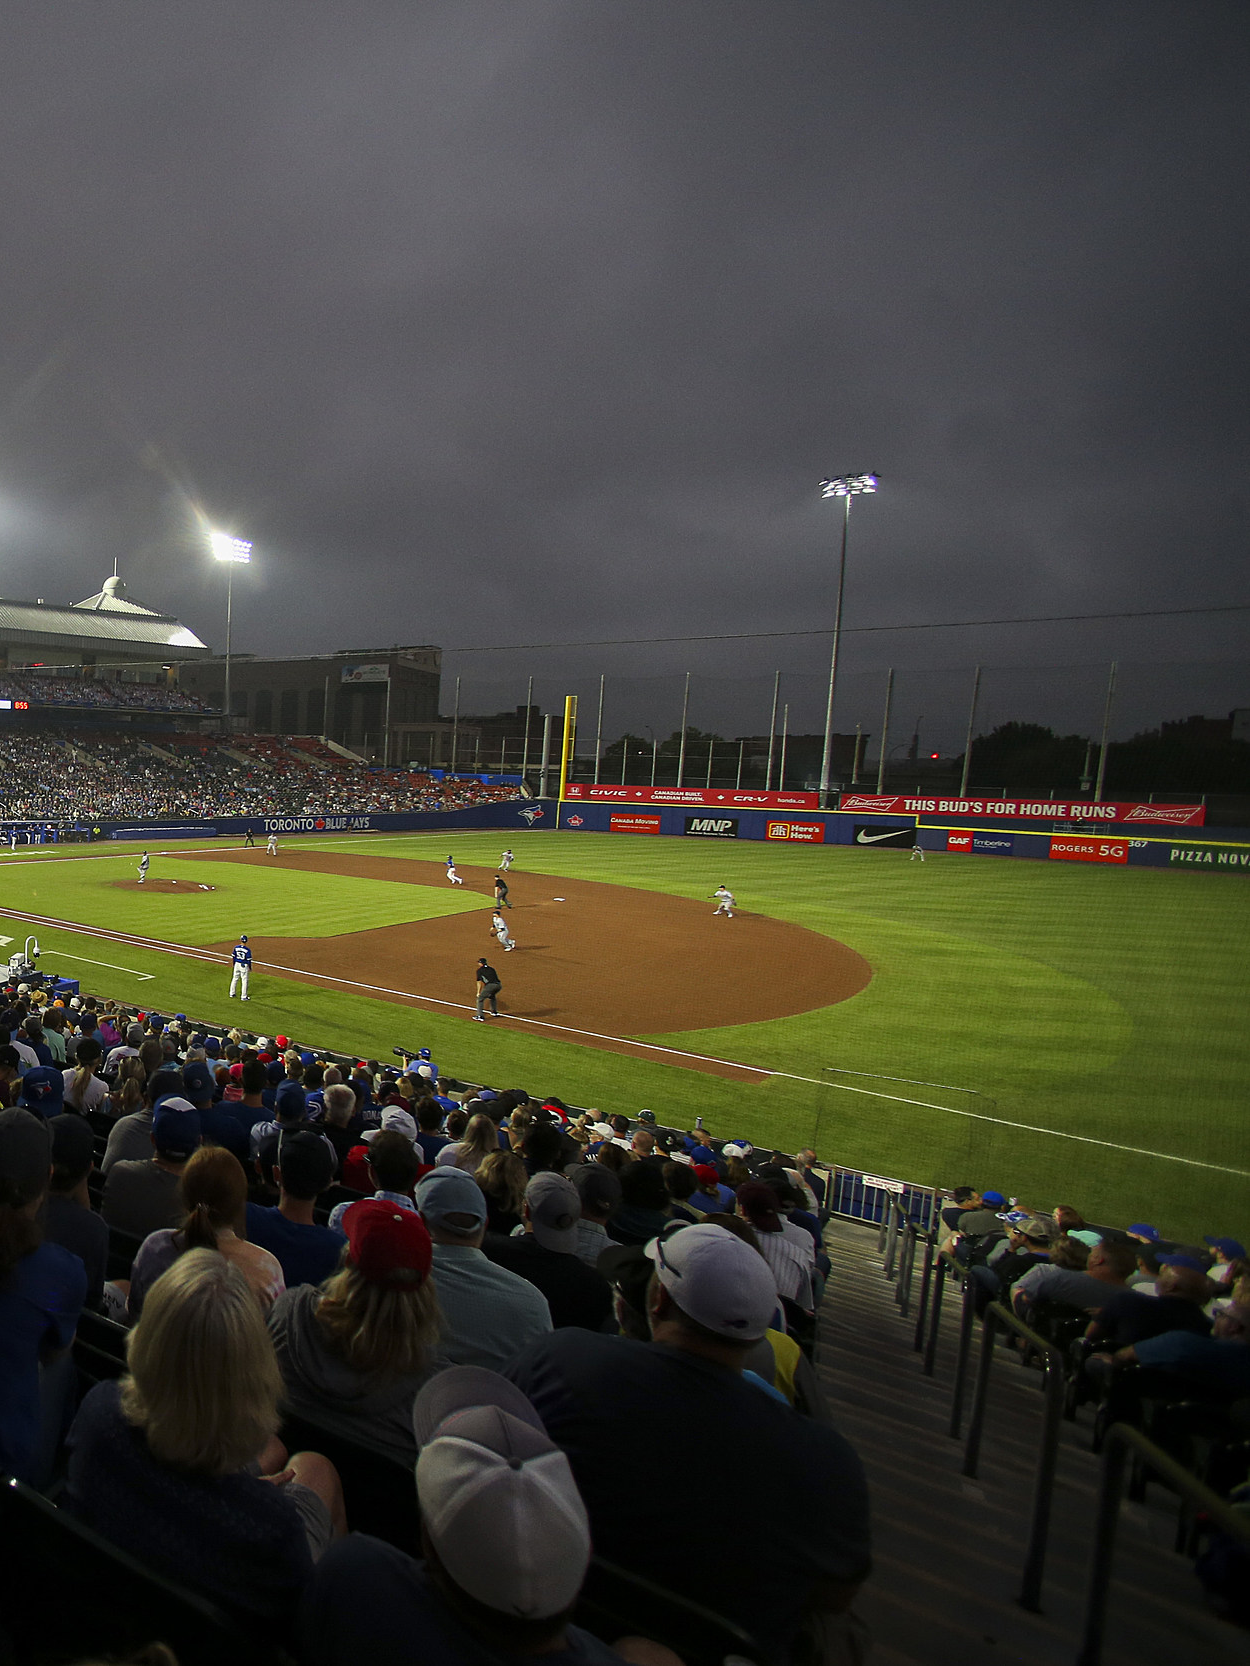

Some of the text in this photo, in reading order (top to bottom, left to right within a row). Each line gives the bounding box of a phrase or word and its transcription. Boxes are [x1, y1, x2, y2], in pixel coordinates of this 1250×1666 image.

[589, 789, 627, 797] CIVIC
[848, 799, 892, 808] Budweiser
[904, 800, 1116, 819] THIS BUD'S FOR HOME RUNS
[1133, 809, 1192, 820] Budweiser
[264, 818, 314, 831] TORONTO
[325, 818, 346, 830] BLUE
[691, 819, 732, 832] MNP
[790, 825, 820, 833] Here's
[948, 836, 970, 845] GAF
[973, 838, 1011, 848] Timberline
[1127, 840, 1148, 848] 367
[1051, 844, 1124, 857] ROGERS 5G
[1170, 849, 1213, 863] PIZZA
[236, 951, 246, 960] 53
